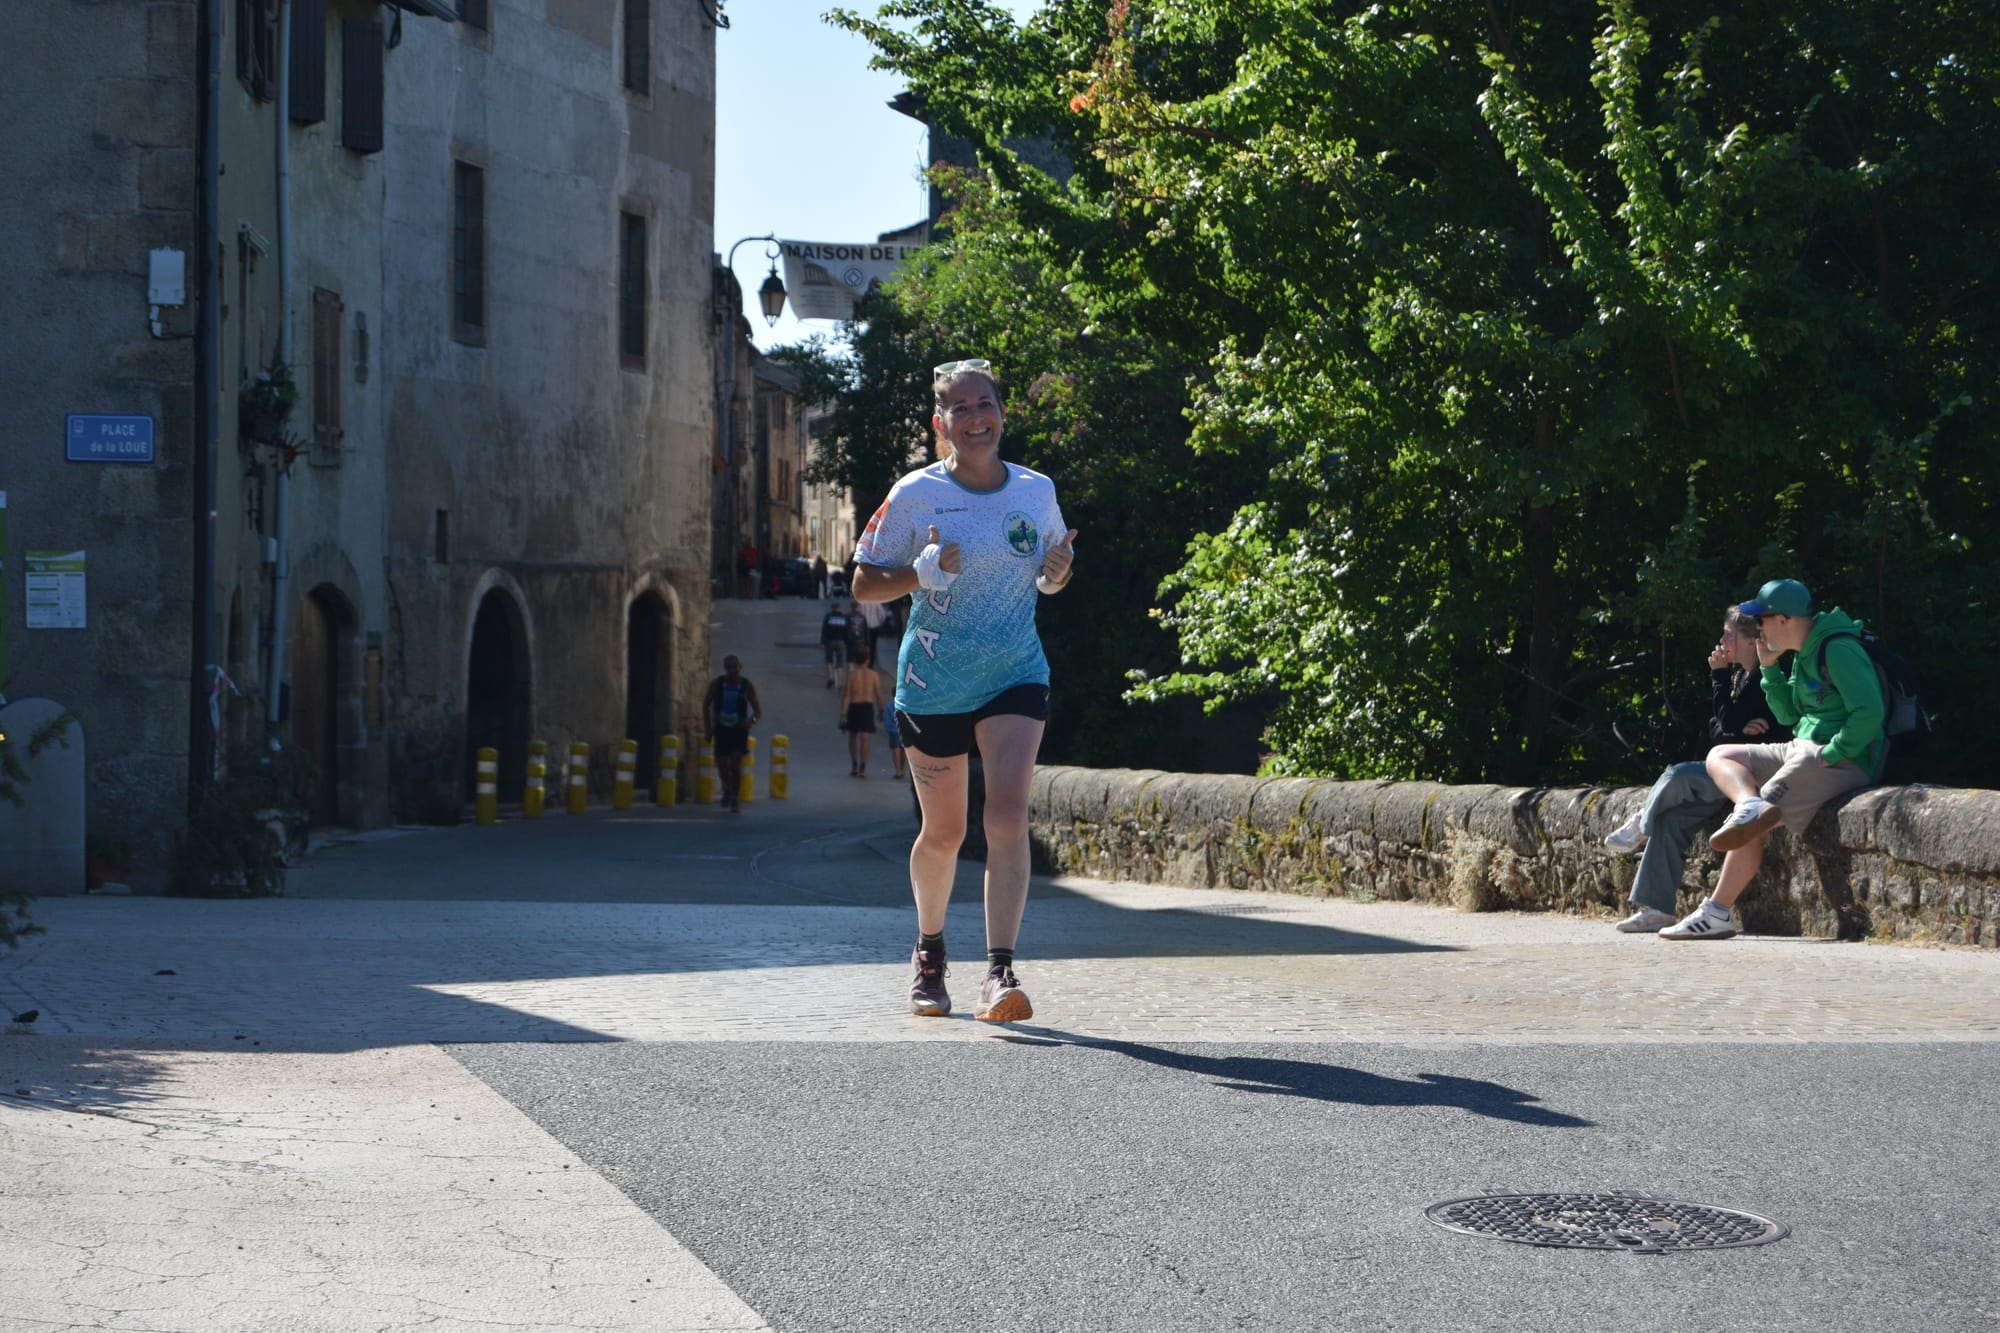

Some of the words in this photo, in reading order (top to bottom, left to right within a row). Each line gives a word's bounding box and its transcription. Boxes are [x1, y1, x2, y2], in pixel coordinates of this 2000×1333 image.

[787, 245, 864, 260] MAISON
[871, 246, 896, 260] DE
[101, 423, 136, 436] PLACE
[90, 441, 102, 452] de
[106, 440, 116, 452] la
[119, 441, 148, 454] LOUE
